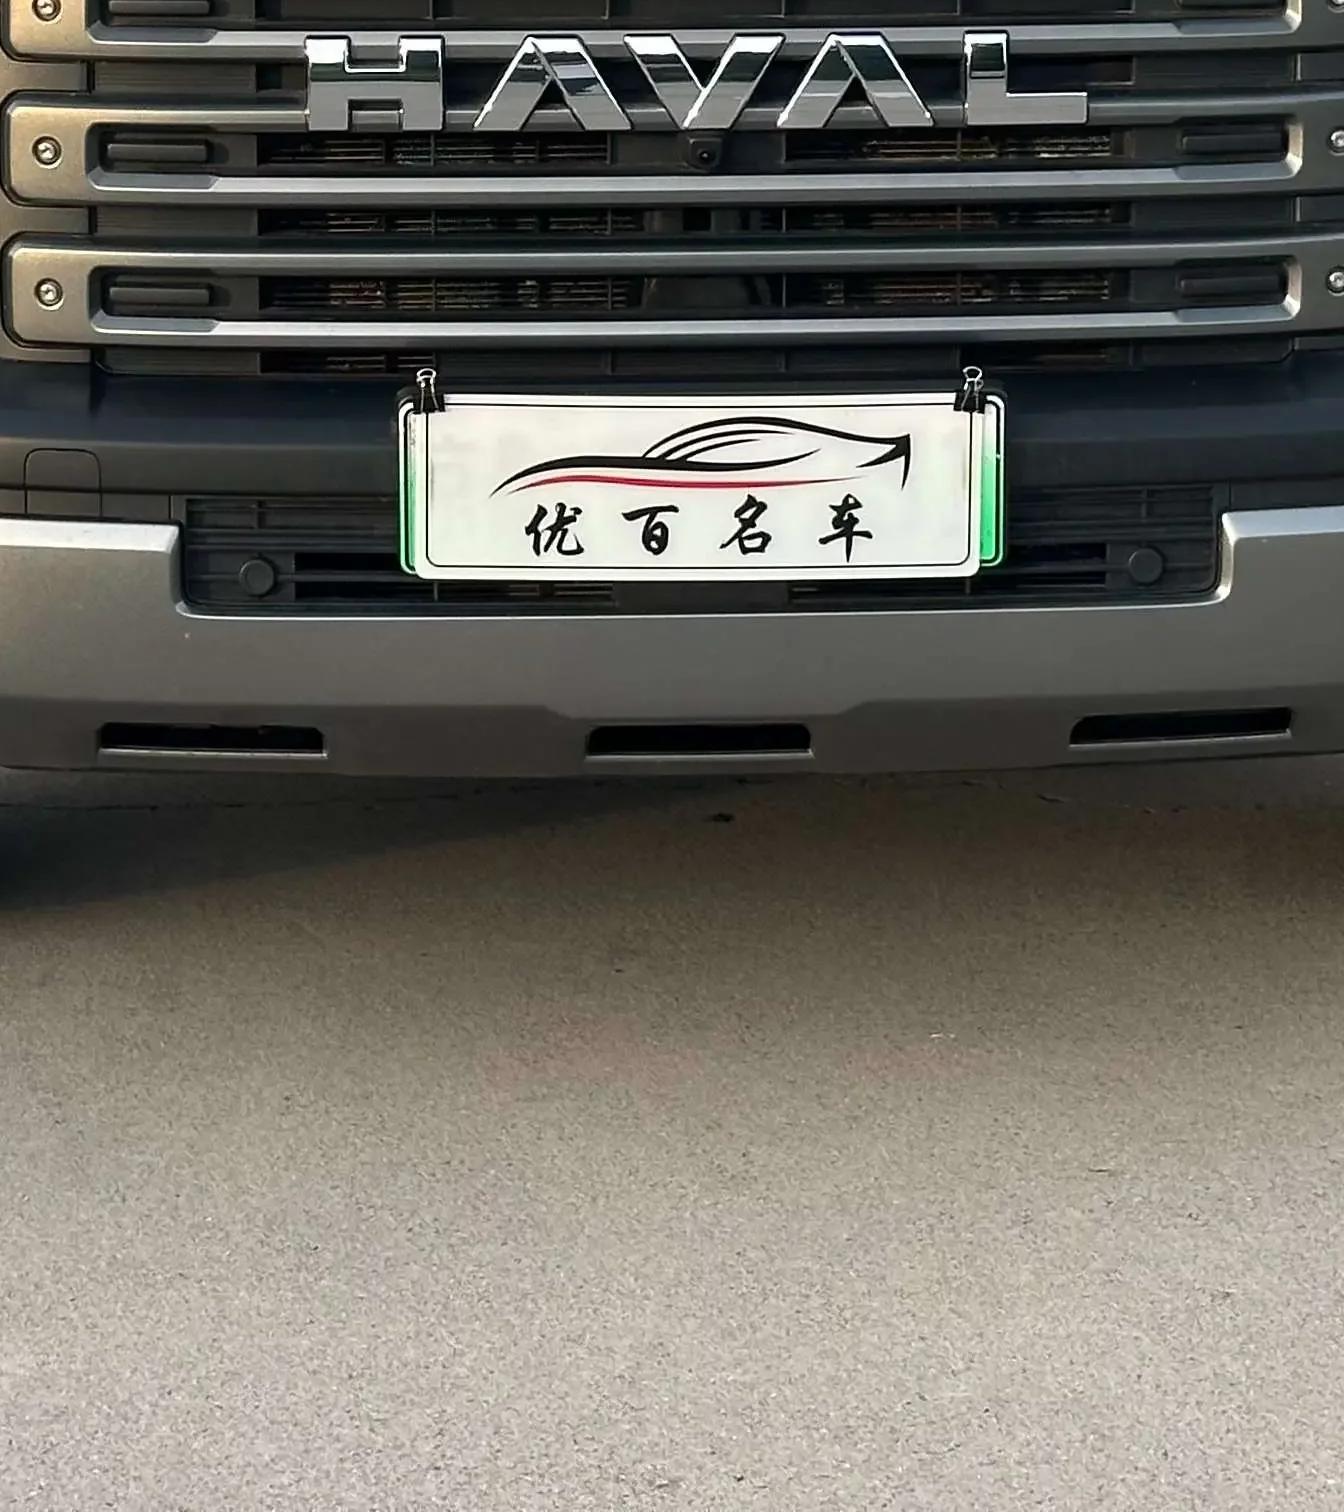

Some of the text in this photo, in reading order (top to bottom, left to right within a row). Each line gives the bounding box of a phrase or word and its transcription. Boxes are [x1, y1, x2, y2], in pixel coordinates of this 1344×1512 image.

[304, 31, 1088, 131] HAVAL
[524, 493, 874, 563] 优百名车
